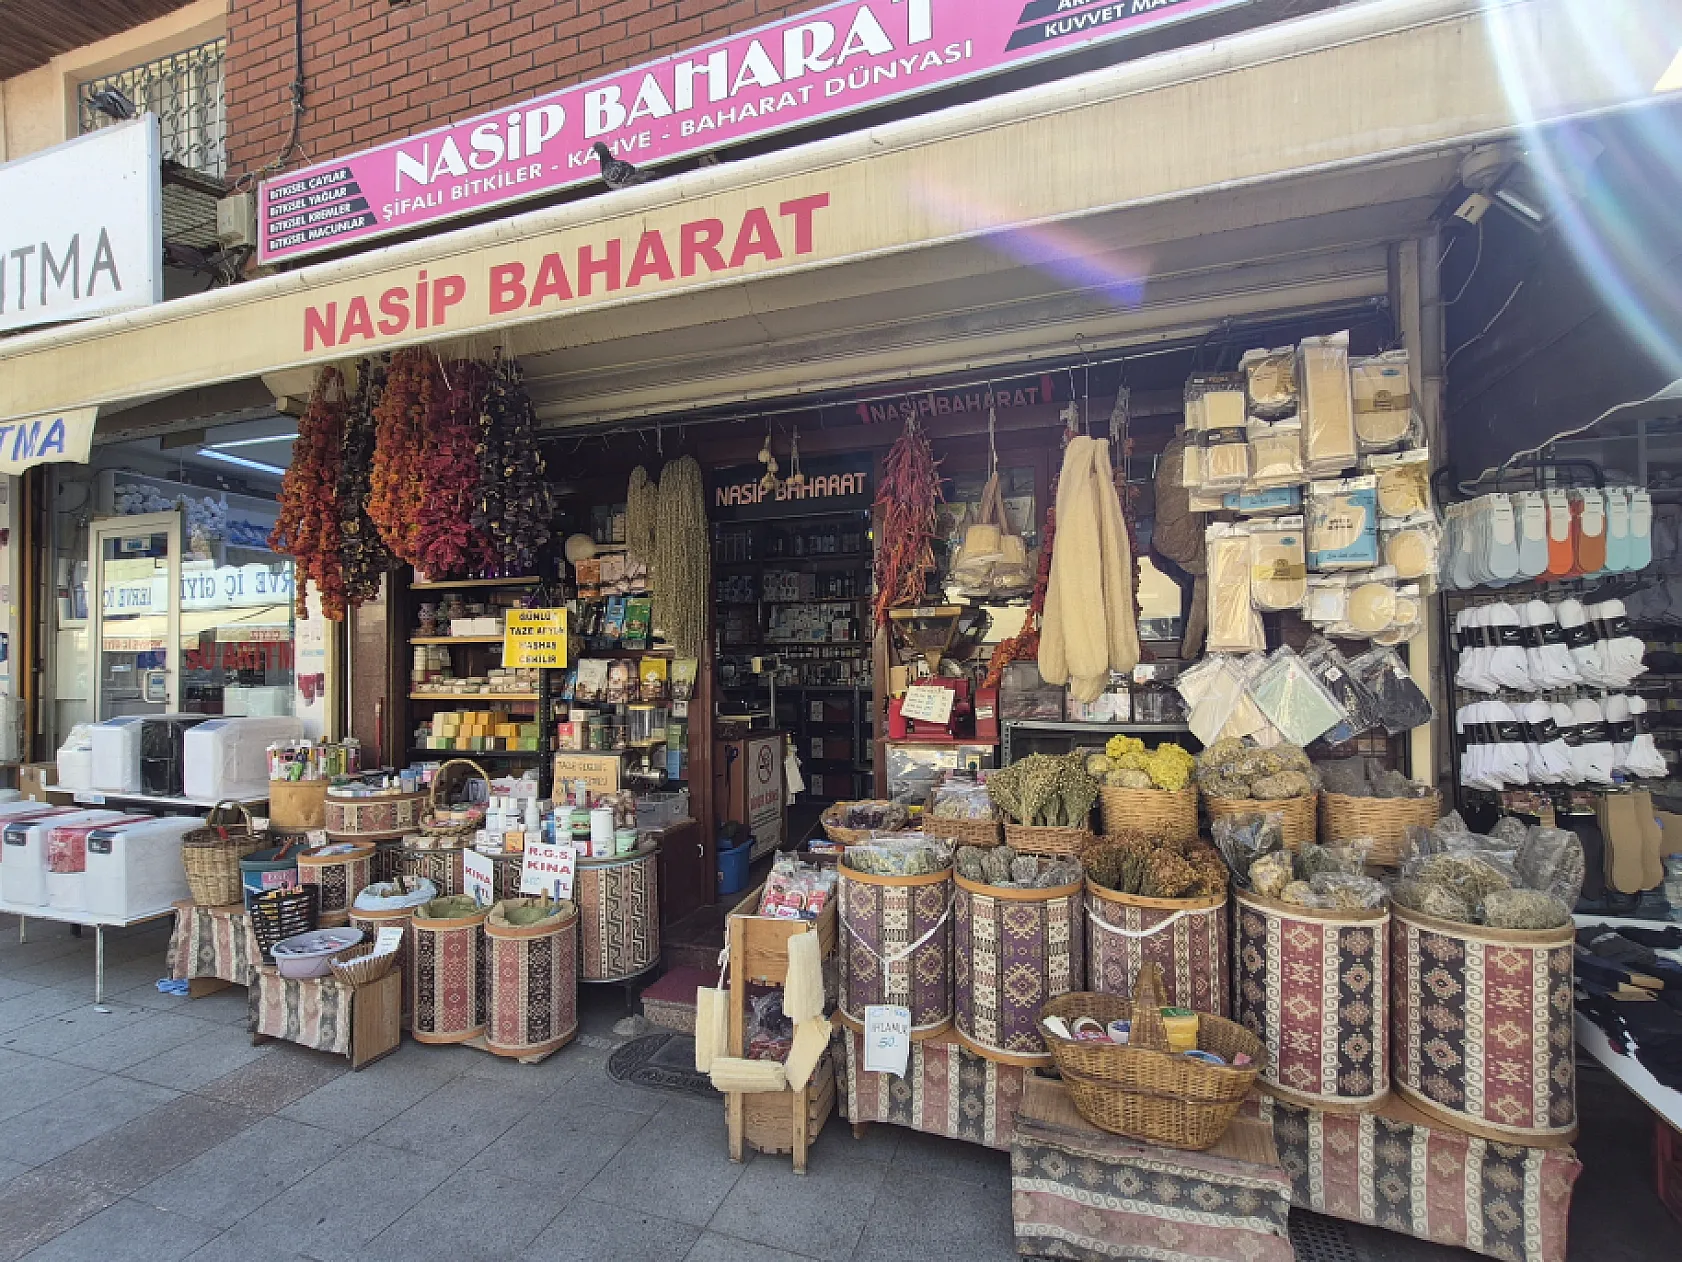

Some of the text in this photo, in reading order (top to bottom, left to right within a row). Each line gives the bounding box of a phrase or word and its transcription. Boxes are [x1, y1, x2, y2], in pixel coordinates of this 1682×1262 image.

[1045, 3, 1125, 38] KUVVET
[584, 0, 934, 139] BAHARAT
[382, 191, 443, 222] ŞİFALI
[451, 163, 543, 200] BİTKİLER
[681, 84, 813, 138] BAHARAT
[825, 39, 973, 98] DÜNYASI
[309, 203, 351, 223] KREMLER
[309, 216, 365, 240] MACUNLAR
[302, 192, 829, 352] NASİP BAHARAT
[940, 387, 1039, 415] BAHARAT
